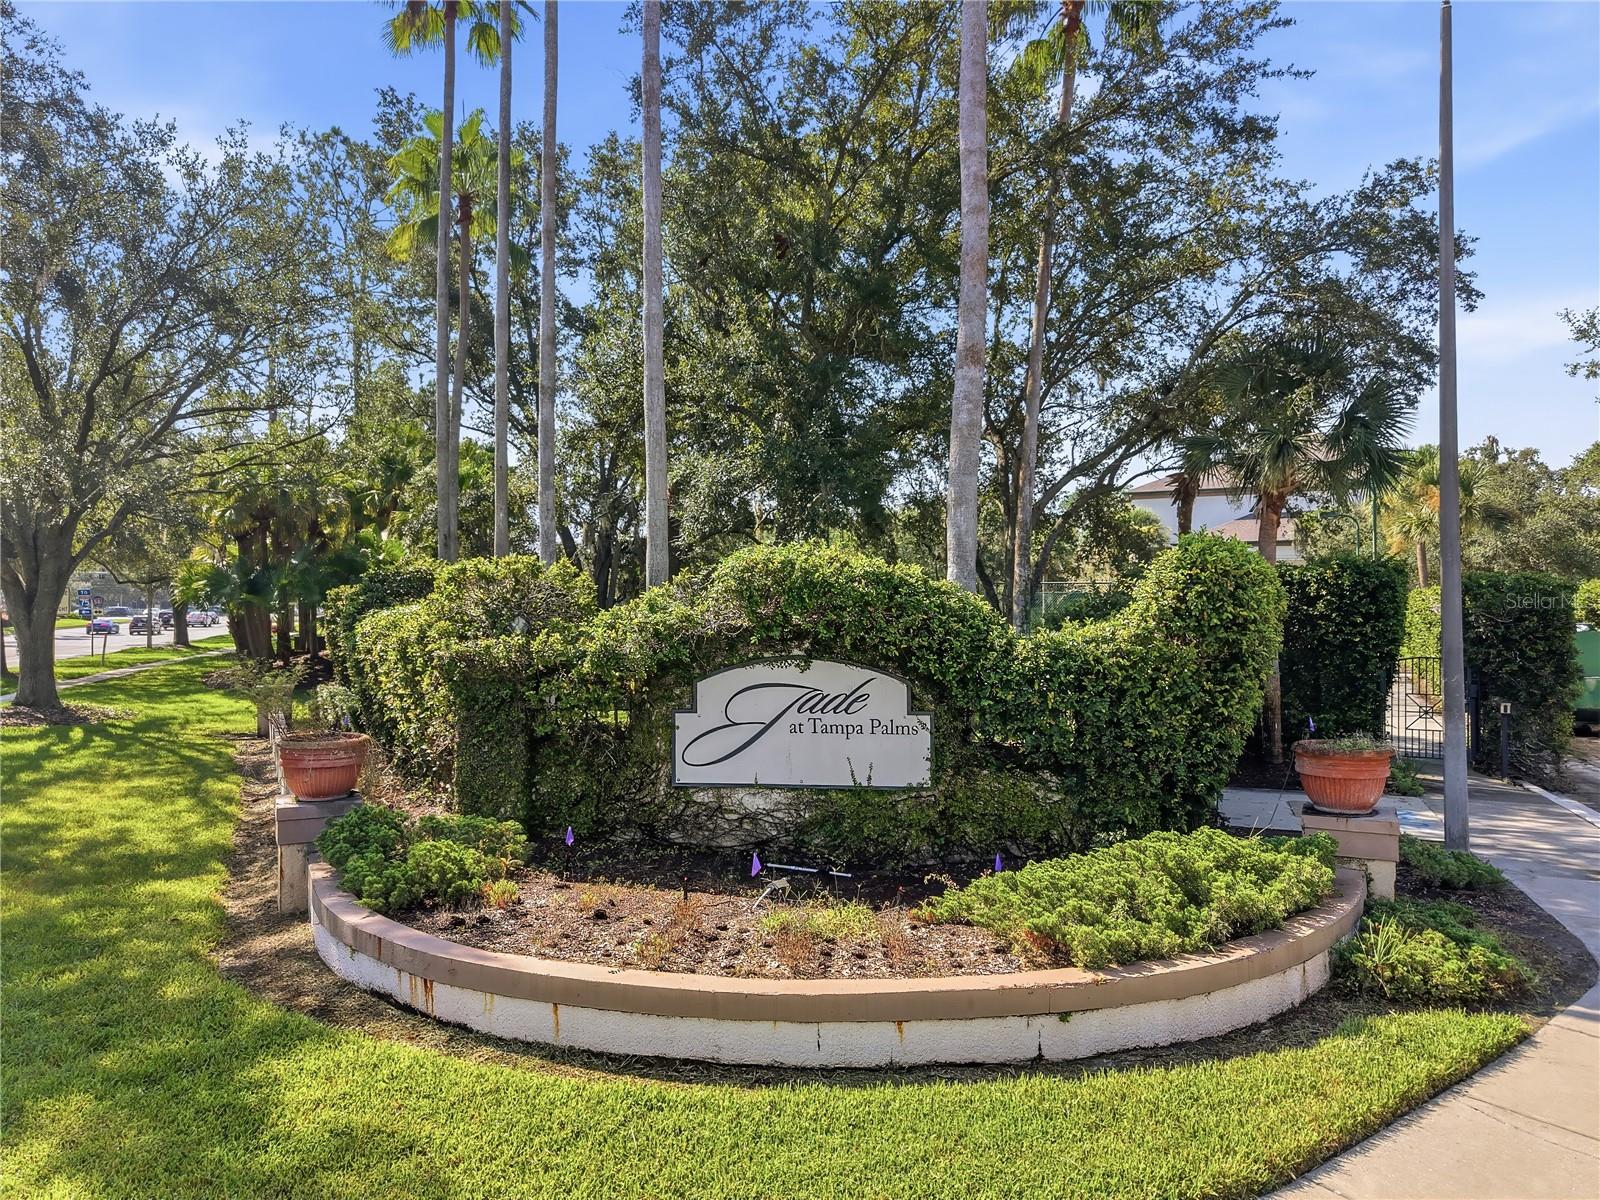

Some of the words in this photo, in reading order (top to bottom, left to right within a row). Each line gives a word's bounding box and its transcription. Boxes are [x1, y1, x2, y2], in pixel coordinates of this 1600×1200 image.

[682, 677, 877, 767] Jade
[789, 721, 804, 734] at
[807, 718, 864, 739] Tampa
[869, 718, 919, 736] Palms
